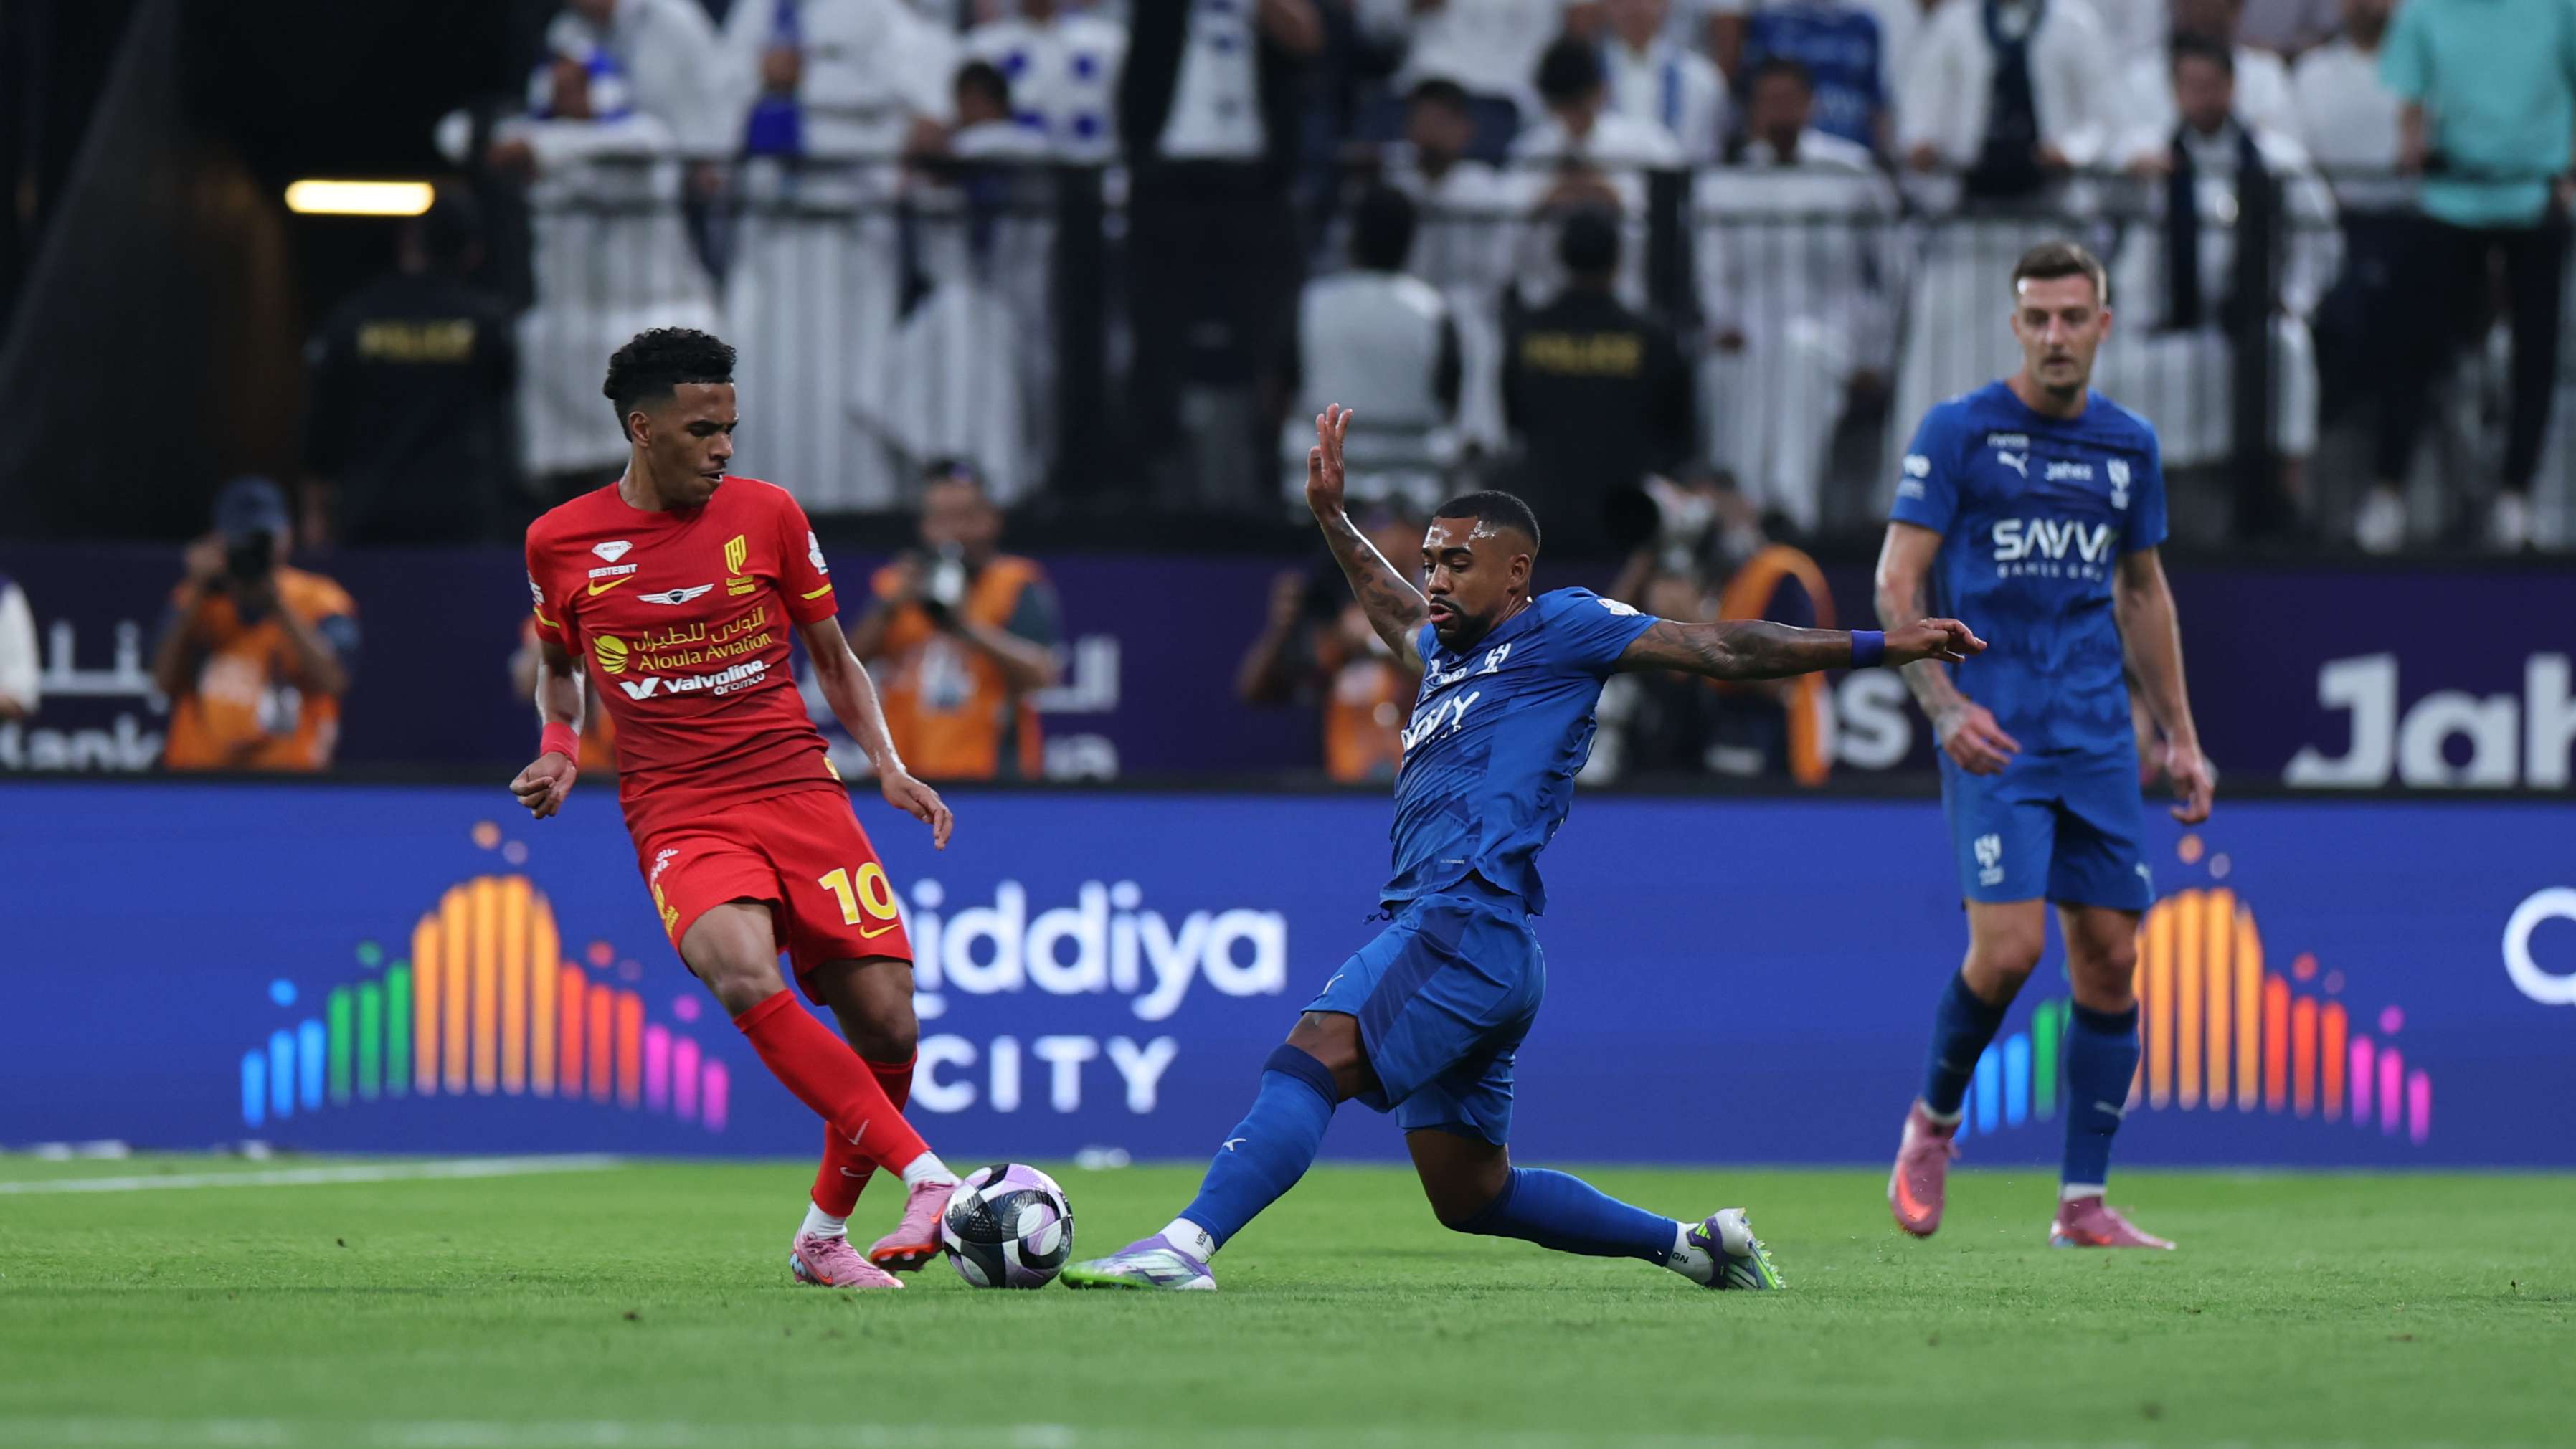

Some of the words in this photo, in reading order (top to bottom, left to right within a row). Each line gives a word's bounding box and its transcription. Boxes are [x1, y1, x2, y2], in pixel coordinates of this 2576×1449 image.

[588, 564, 638, 579] BESTEBIT
[633, 623, 706, 652] للطيران
[638, 648, 702, 671] Aloula
[706, 633, 772, 661] Aviation
[663, 660, 764, 693] Valvoline
[818, 862, 897, 925] 10
[896, 878, 1287, 1021] iddiya
[912, 1033, 1178, 1115] CITY
